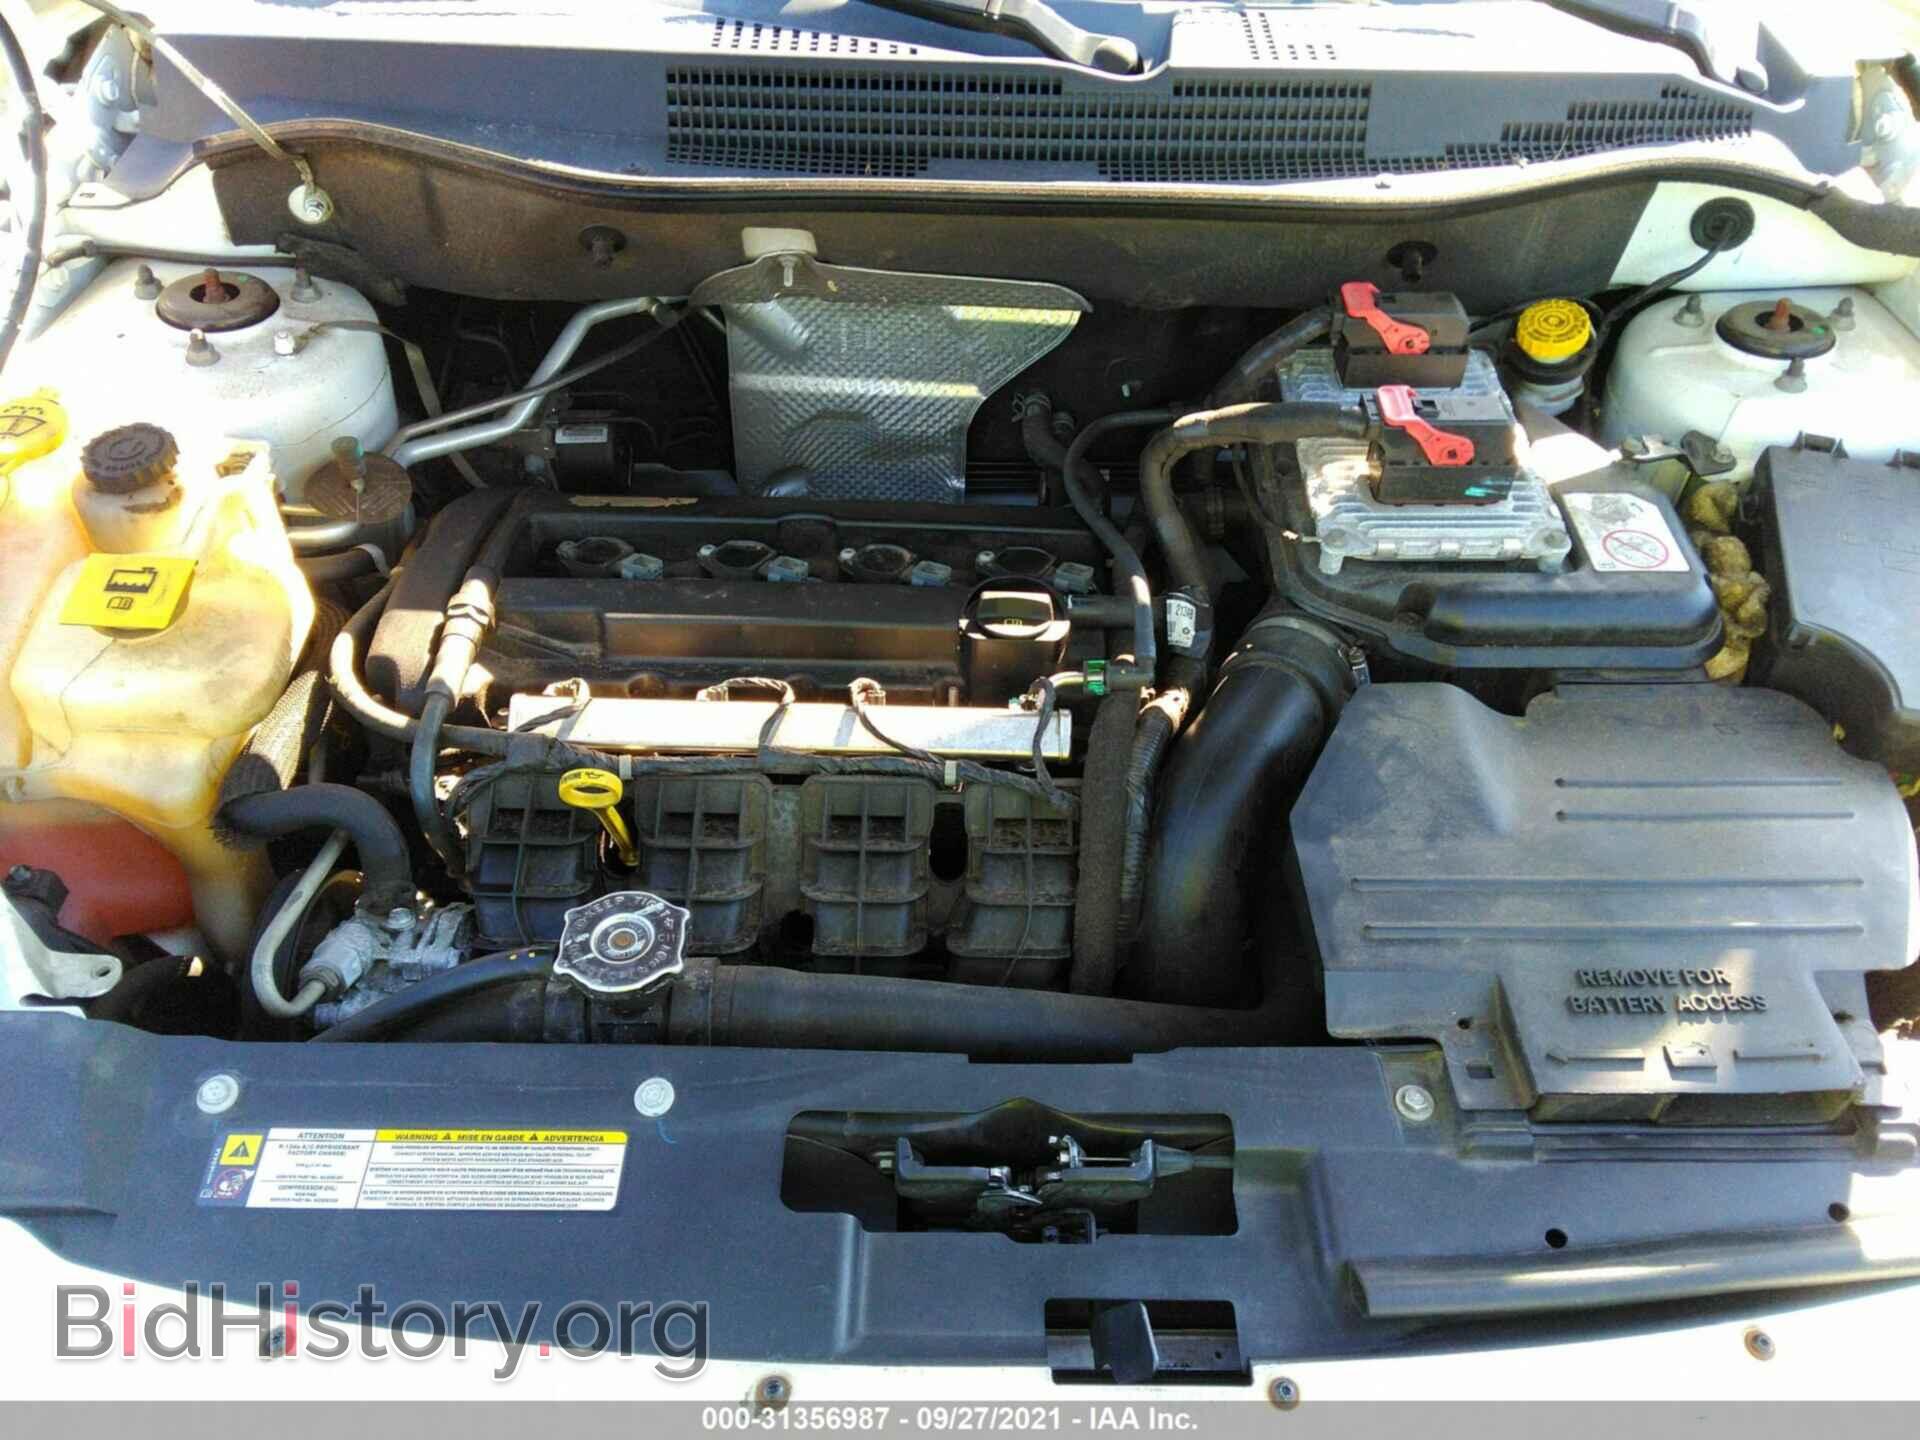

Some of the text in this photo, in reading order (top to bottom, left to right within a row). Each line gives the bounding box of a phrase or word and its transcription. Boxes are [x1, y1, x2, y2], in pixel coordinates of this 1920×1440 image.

[1577, 967, 1732, 986] REMOVE FOR
[1570, 993, 1769, 1014] BATTERY ACCESS
[297, 1132, 346, 1140] ATTENTION
[395, 1133, 438, 1141] WARNING
[495, 1134, 525, 1142] GARDE
[543, 1134, 604, 1142] ADVERTENCIA
